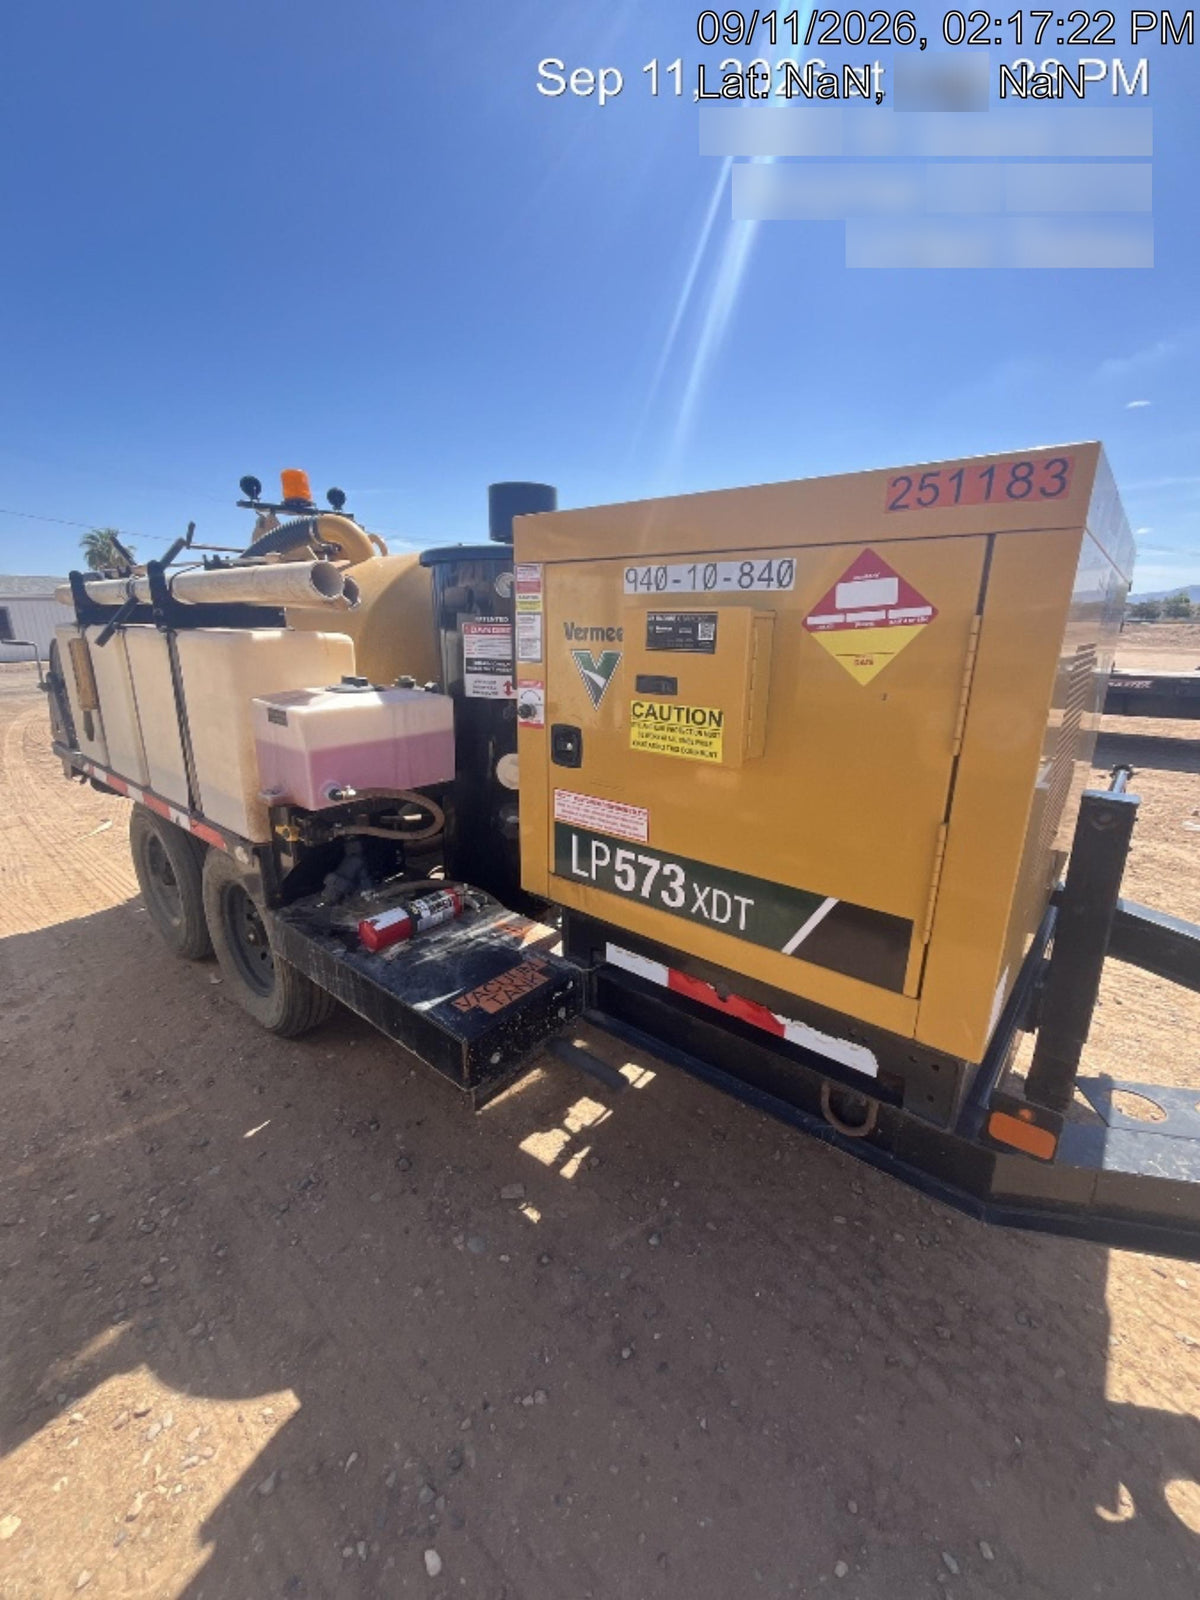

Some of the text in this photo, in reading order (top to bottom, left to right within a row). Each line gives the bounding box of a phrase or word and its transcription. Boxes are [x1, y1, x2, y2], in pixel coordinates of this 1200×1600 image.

[888, 457, 1069, 511] 251183
[625, 559, 794, 592] 940-10-840
[563, 621, 624, 642] Vermee
[632, 702, 724, 728] CAUTION
[571, 833, 755, 931] LP573 XDT
[485, 974, 539, 1005] TANK
